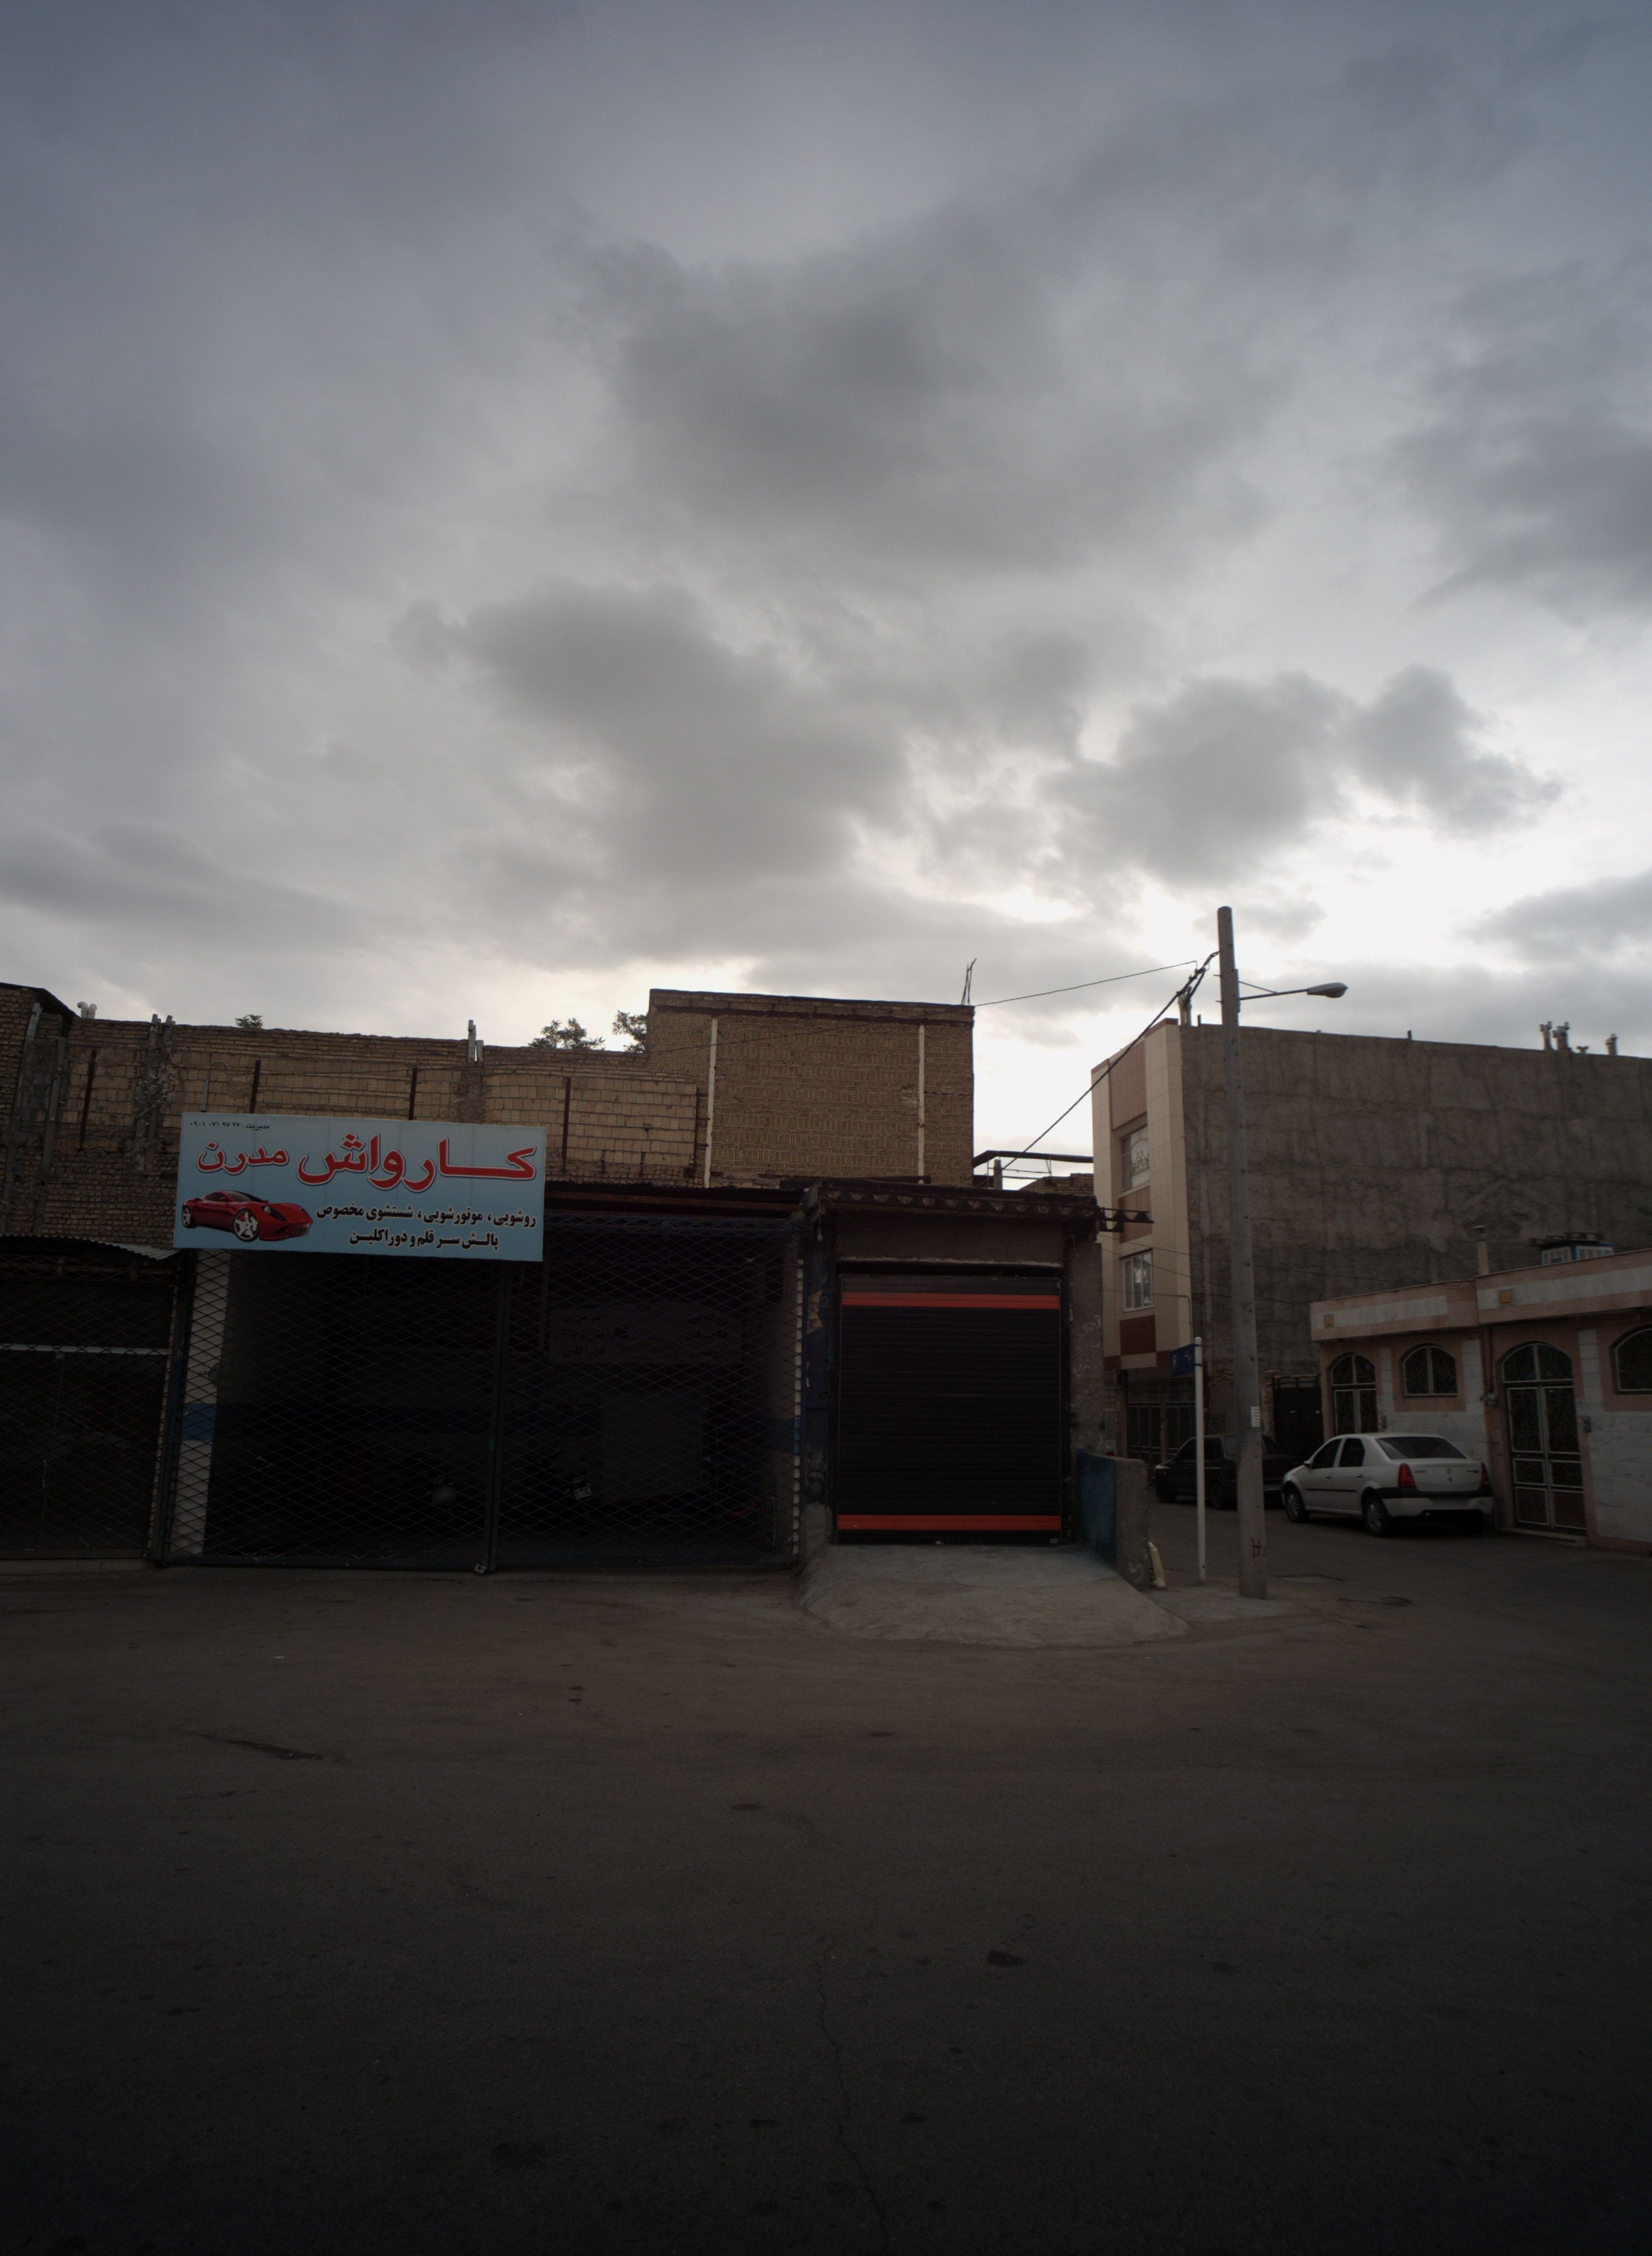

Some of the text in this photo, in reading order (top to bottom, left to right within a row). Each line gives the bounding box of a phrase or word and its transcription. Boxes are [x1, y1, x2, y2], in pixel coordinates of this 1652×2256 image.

[197, 1132, 536, 1192] کارواش مدرن
[317, 1202, 364, 1219] مخصوص
[409, 1235, 415, 1247] و
[417, 1229, 434, 1248] قلم
[436, 1237, 460, 1248] سر
